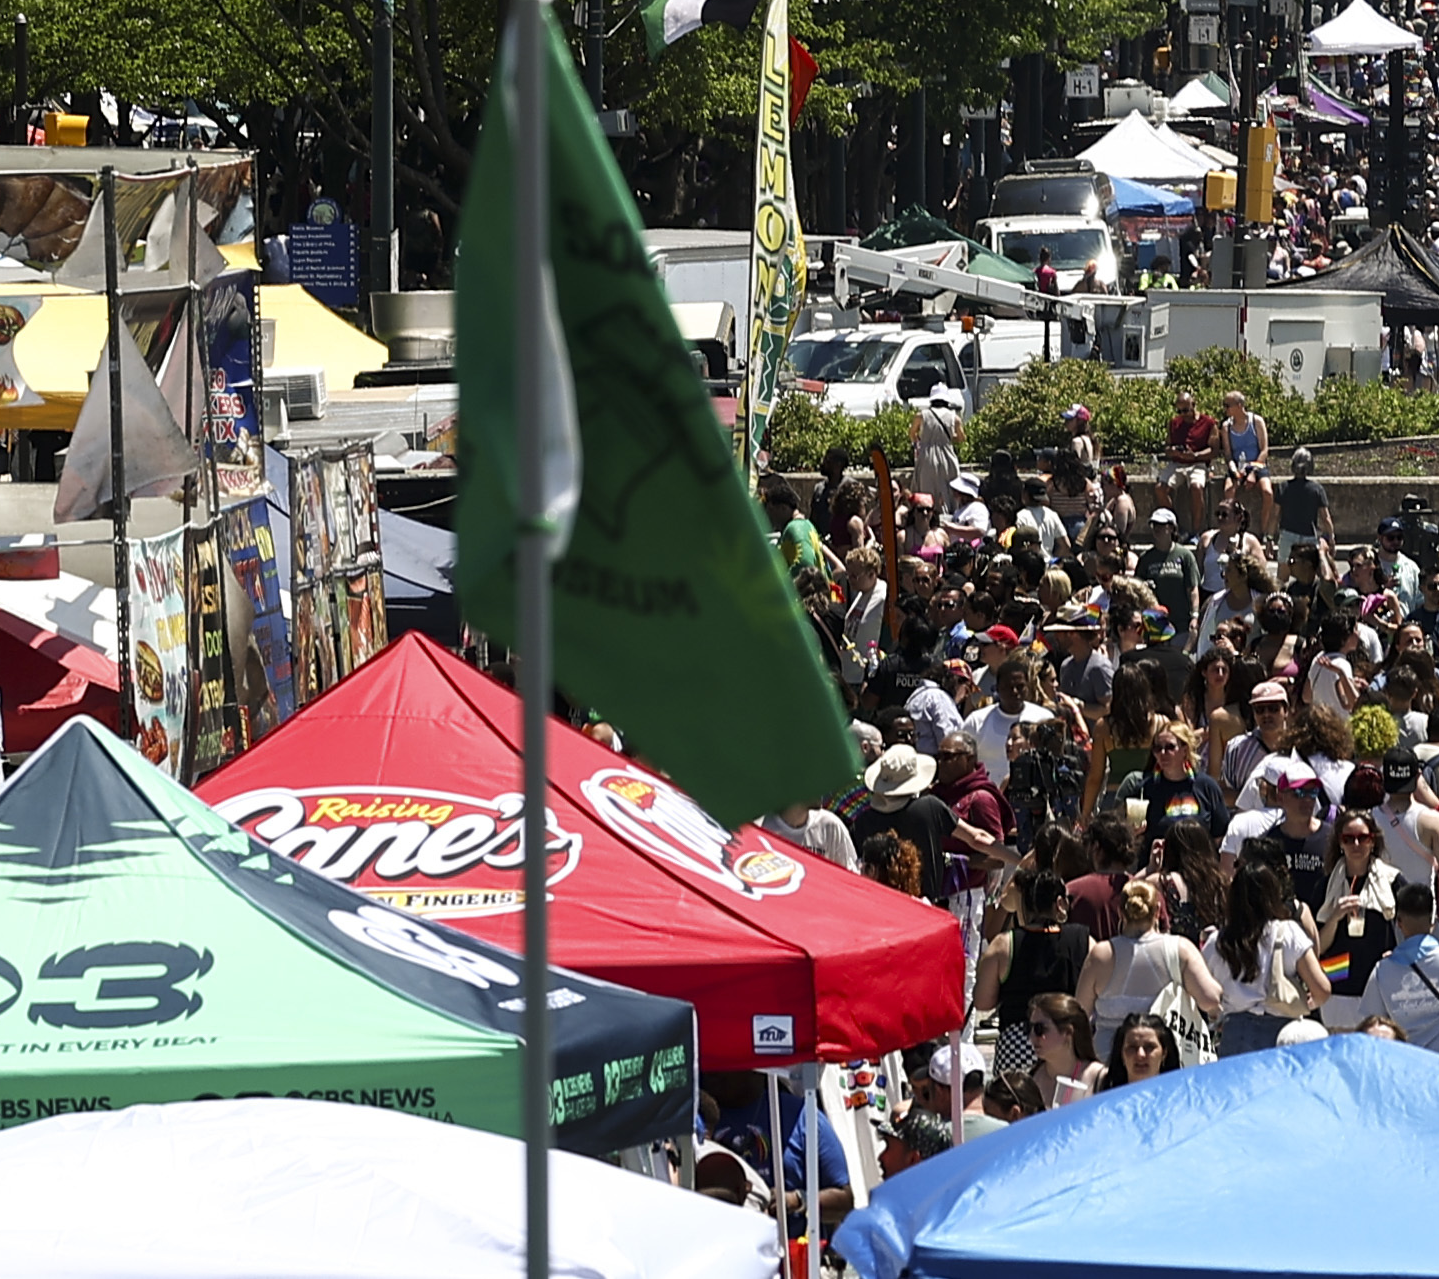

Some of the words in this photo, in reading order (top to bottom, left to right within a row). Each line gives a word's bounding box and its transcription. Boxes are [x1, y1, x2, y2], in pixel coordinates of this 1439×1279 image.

[1072, 80, 1096, 95] H-1
[308, 797, 454, 826] Raising
[27, 941, 216, 1029] 3
[20, 1042, 54, 1054] IN
[57, 1038, 148, 1053] EVERY
[150, 1034, 222, 1048] BEAT
[34, 1096, 113, 1119] NEWS
[359, 1086, 437, 1109] NEWS
